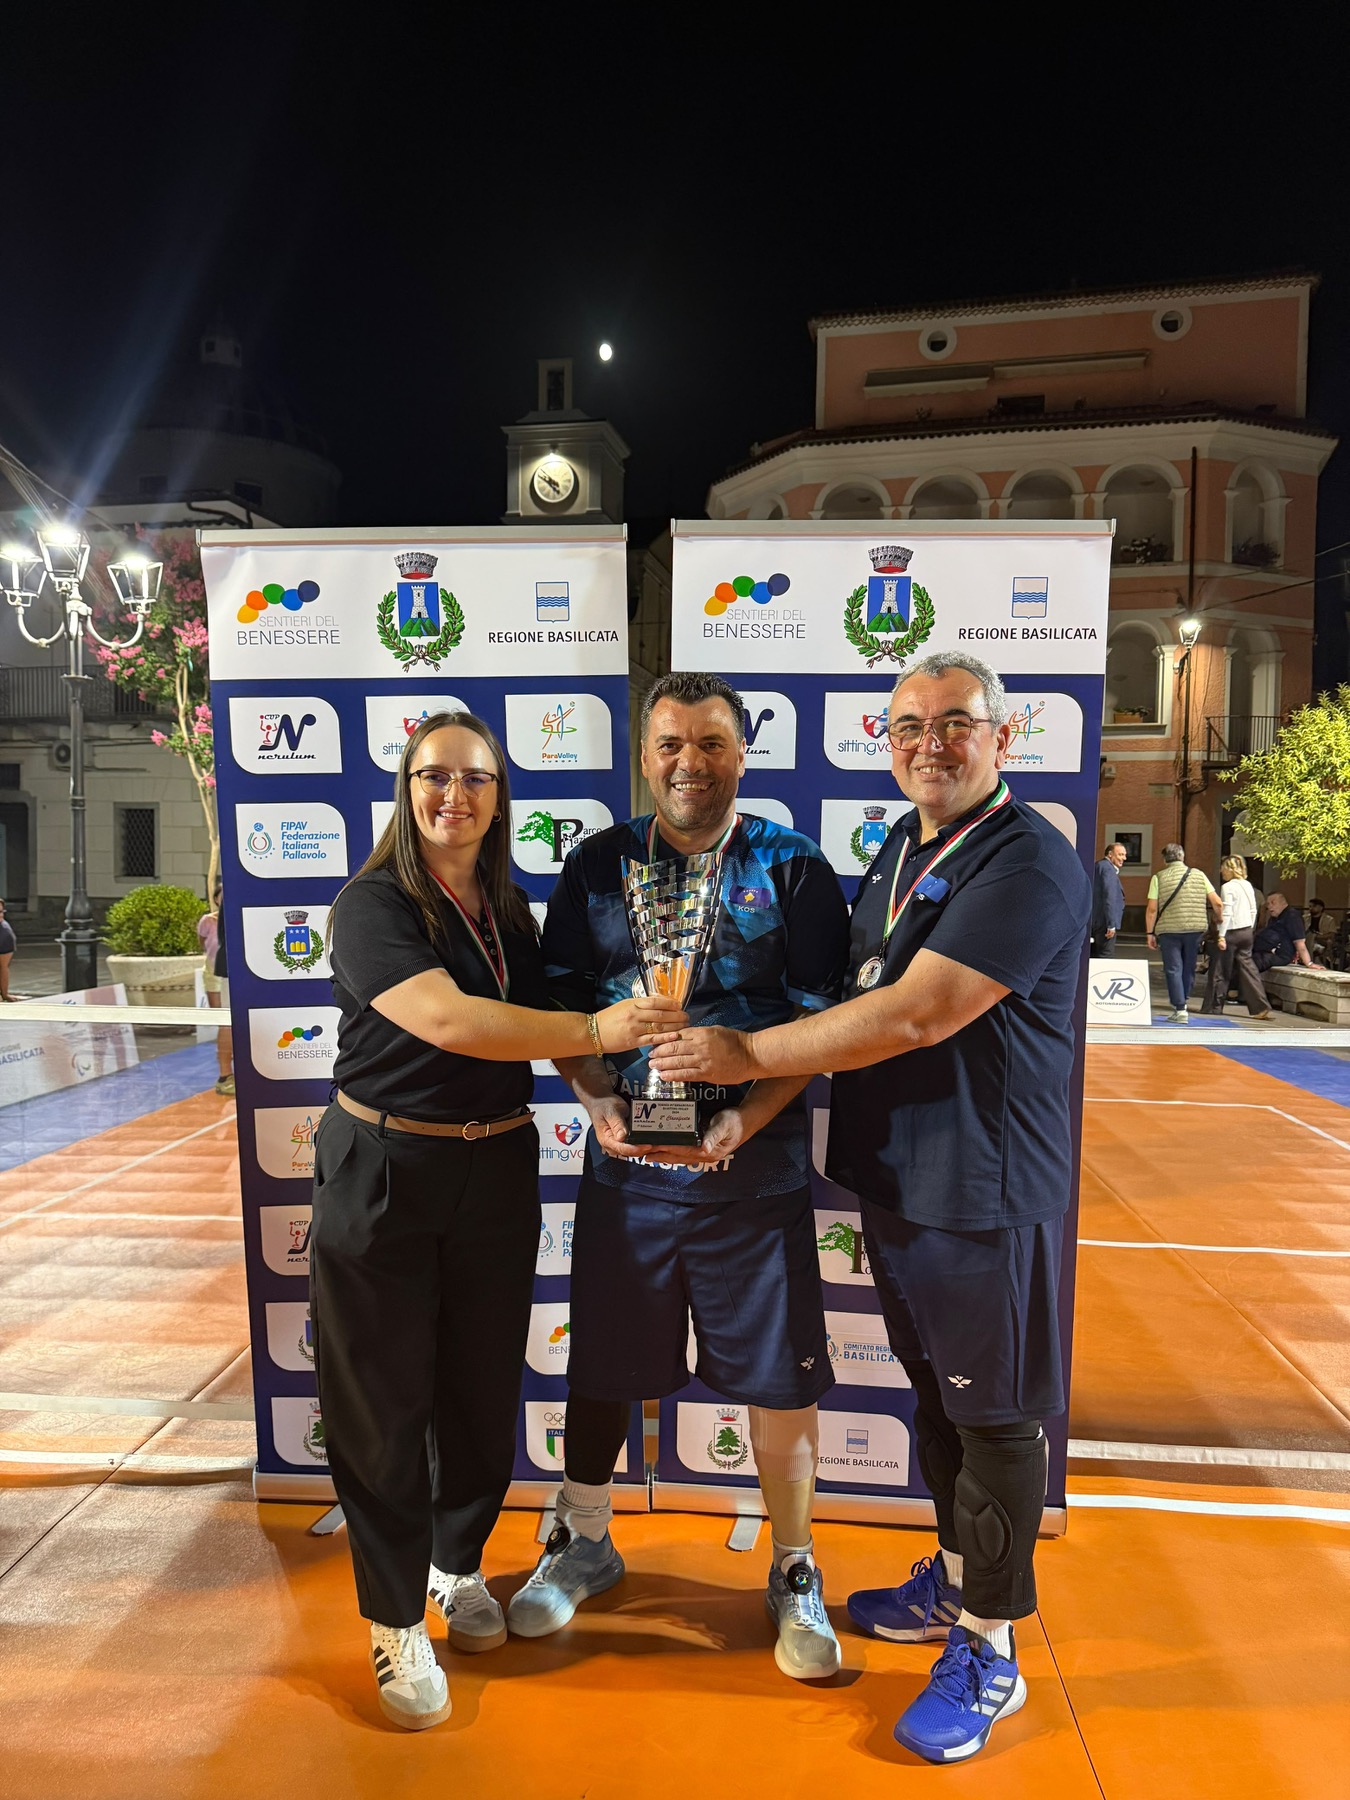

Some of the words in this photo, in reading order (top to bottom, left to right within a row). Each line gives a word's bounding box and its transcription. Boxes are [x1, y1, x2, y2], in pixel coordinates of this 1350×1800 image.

[727, 609, 778, 620] SENTIERI
[782, 609, 806, 620] DEL
[259, 616, 311, 627] SENTIERI
[315, 615, 339, 627] DEL
[703, 623, 806, 639] BENESSERE
[958, 627, 1018, 640] REGIONE
[1021, 627, 1097, 640] BASILICATA
[237, 630, 341, 645] BENESSERE
[488, 631, 544, 643] REGIONE
[547, 630, 619, 643] BASILICATA
[838, 739, 892, 756] sittingvo
[258, 752, 317, 760] nerulum
[542, 752, 578, 760] ParaVolley
[1004, 753, 1044, 761] ParaVolley
[281, 821, 307, 831] FIPAV
[281, 831, 340, 841] Federazione
[282, 841, 319, 850] Italiana
[282, 850, 327, 860] Pallavolo
[738, 905, 756, 914] KOS
[277, 1050, 333, 1060] BENESSERE
[843, 1343, 875, 1351] COMITATO
[852, 1458, 899, 1470] BASILICATA
